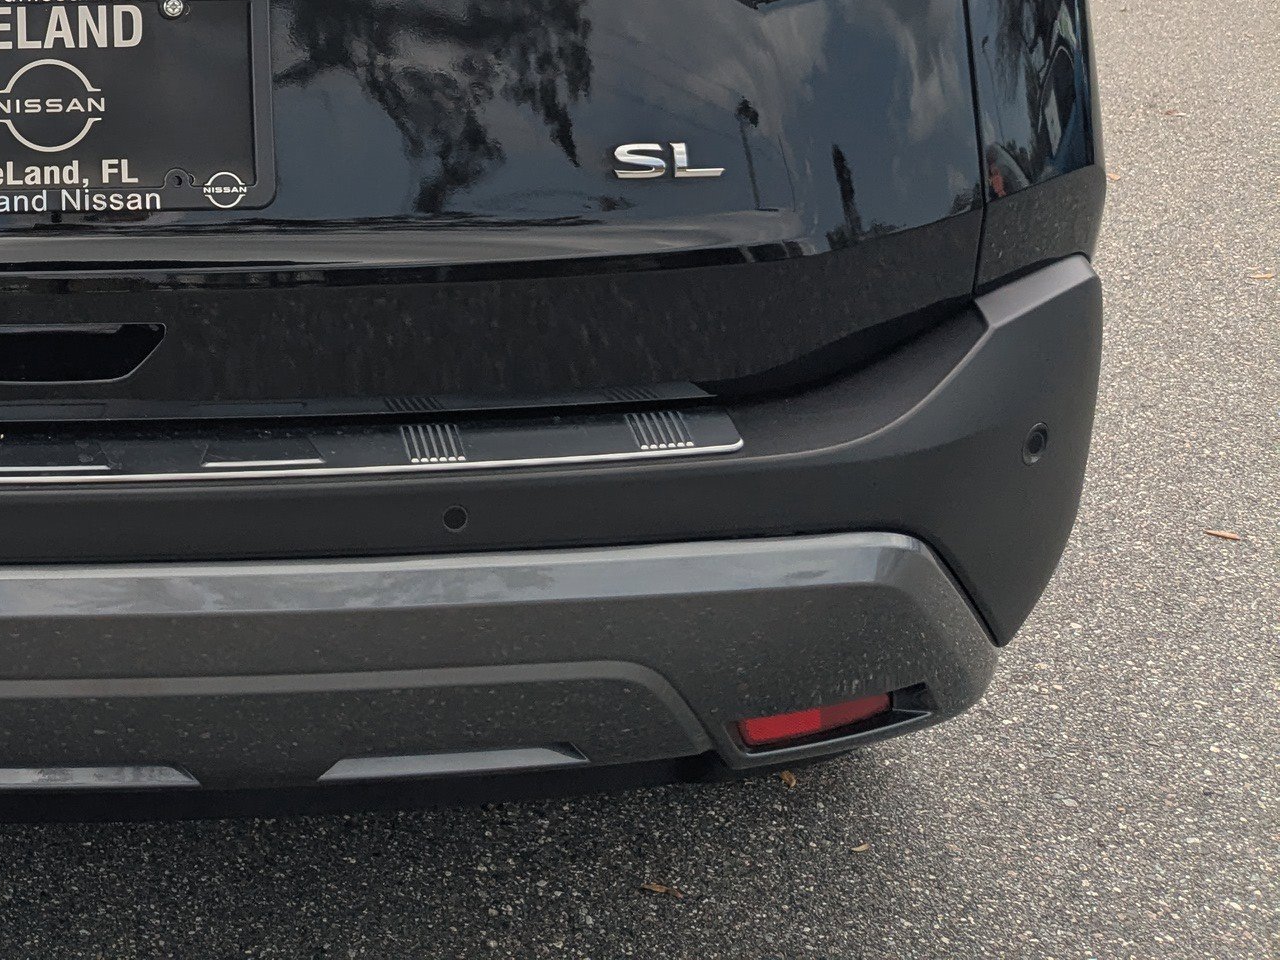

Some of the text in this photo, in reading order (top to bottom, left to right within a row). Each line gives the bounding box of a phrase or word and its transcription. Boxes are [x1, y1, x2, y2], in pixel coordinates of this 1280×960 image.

[101, 158, 139, 184] FL
[613, 142, 726, 179] SL
[59, 188, 162, 212] Nissan
[203, 186, 248, 194] NISSAN
